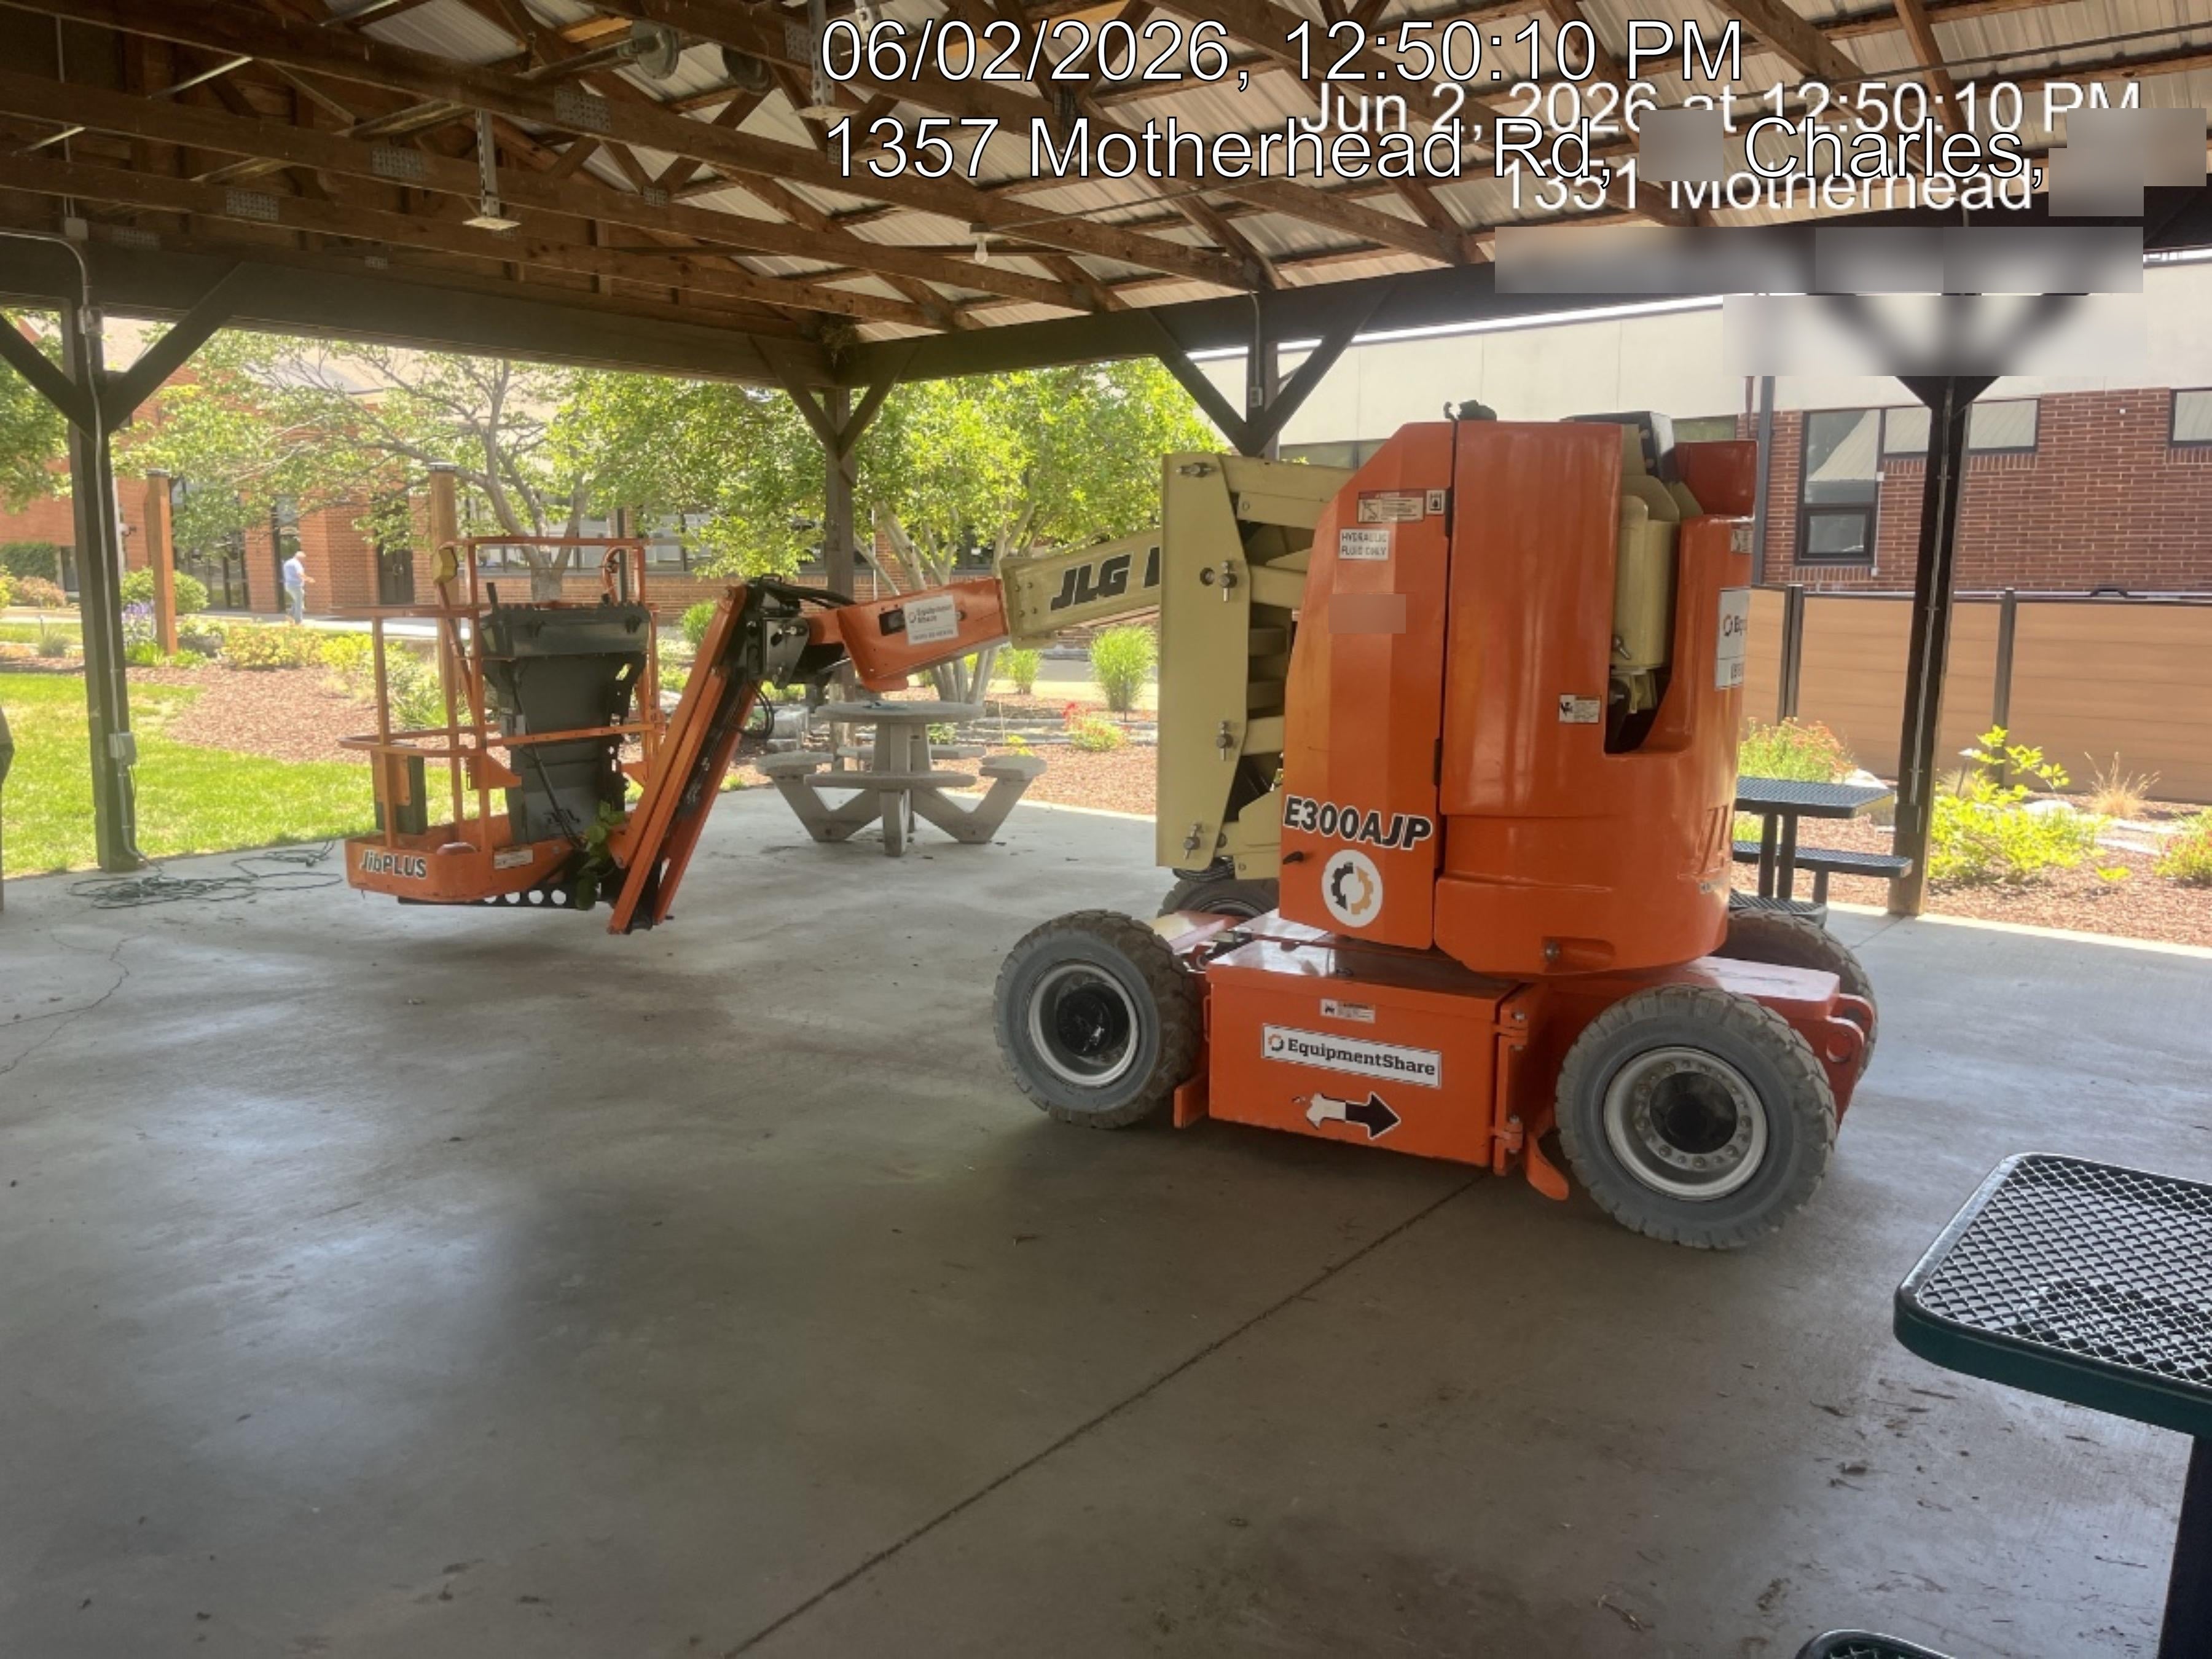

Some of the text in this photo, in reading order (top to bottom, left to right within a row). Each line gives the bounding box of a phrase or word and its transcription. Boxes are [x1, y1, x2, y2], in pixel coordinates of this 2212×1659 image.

[1050, 554, 1131, 611] JLG
[1284, 794, 1433, 850] E300AJP
[360, 850, 428, 879] JibPLUS
[1288, 1037, 1435, 1075] EquipmentShare
